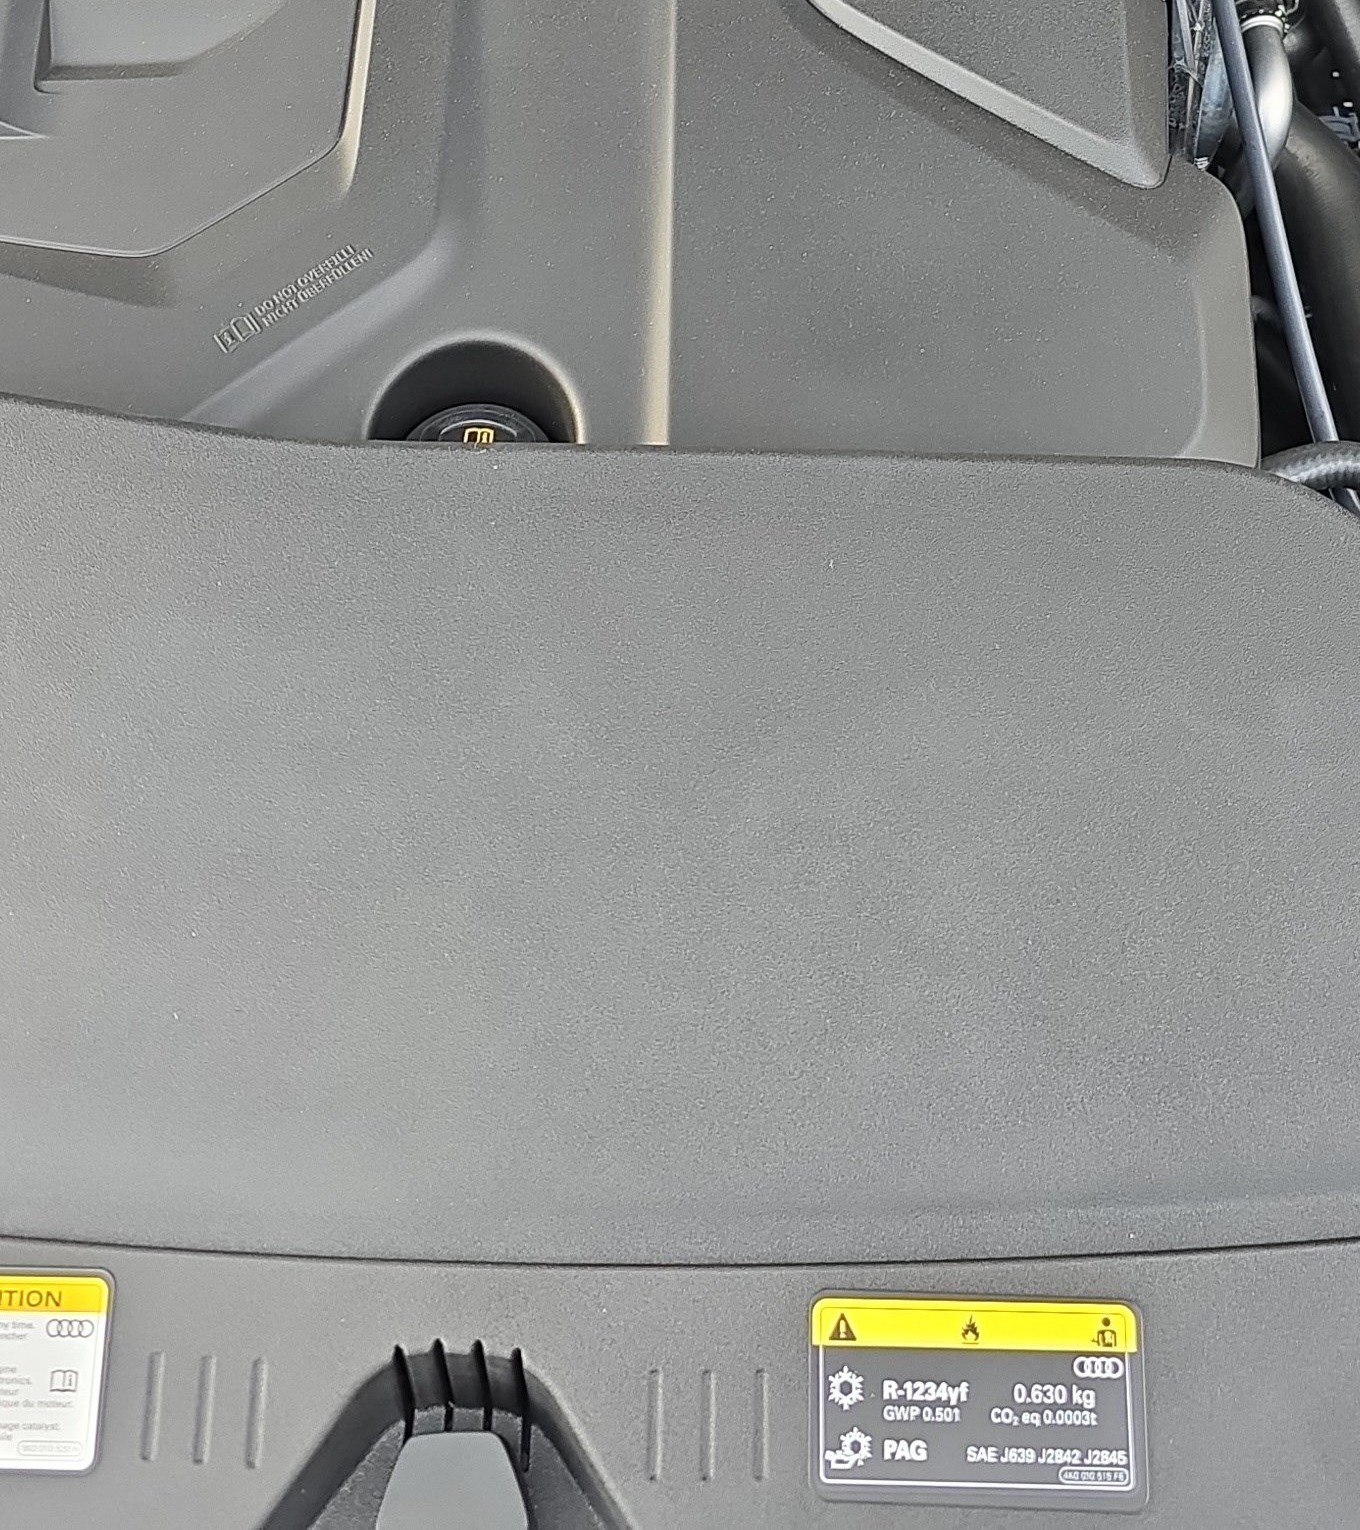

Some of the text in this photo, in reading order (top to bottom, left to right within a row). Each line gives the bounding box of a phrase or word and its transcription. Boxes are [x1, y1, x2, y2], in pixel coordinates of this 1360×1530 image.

[254, 299, 274, 316] DO
[273, 284, 299, 305] NOT
[881, 1379, 1096, 1409] R-1234yf 0.630 kg
[883, 1407, 920, 1422] GWP
[921, 1407, 961, 1423] 0.501
[1021, 1411, 1041, 1428] eq
[882, 1439, 928, 1461] PAG
[966, 1446, 999, 1464] SAE
[1000, 1446, 1037, 1464] J639
[1038, 1447, 1082, 1465] J2842
